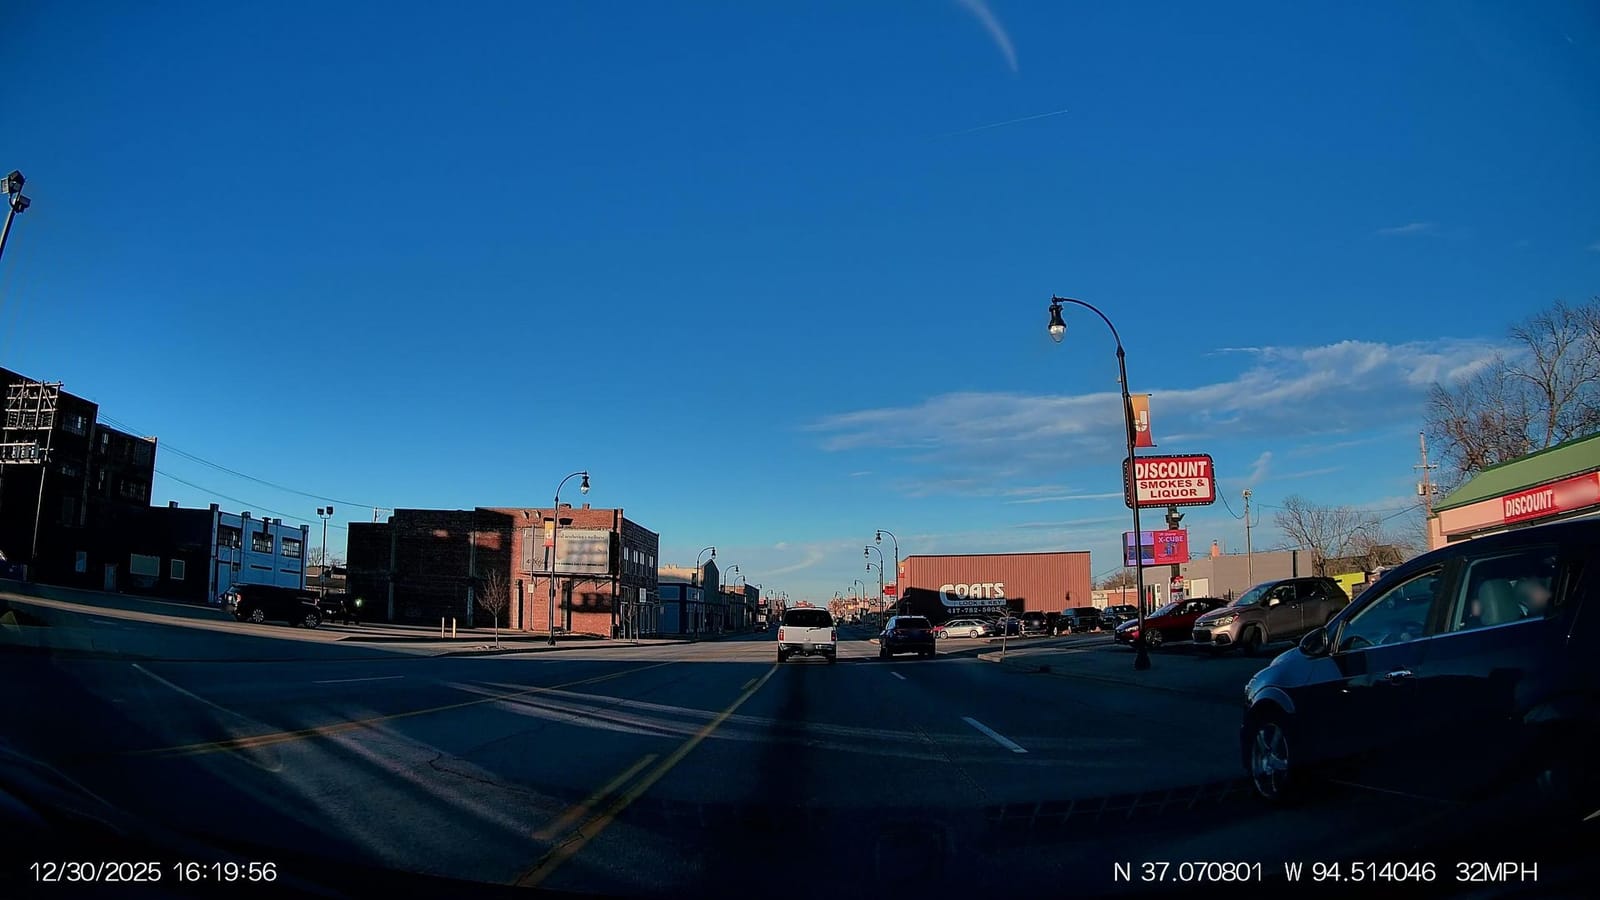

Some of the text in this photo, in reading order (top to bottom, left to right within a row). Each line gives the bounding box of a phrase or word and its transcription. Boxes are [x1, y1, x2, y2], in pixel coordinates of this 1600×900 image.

[1135, 461, 1207, 480] DISCOUNT
[1140, 479, 1205, 489] SMOKES &
[1150, 488, 1198, 498] LIQUOR
[1505, 489, 1553, 517] DISCOUNT
[1158, 535, 1185, 543] X-CUBE
[940, 583, 1005, 606] COATS
